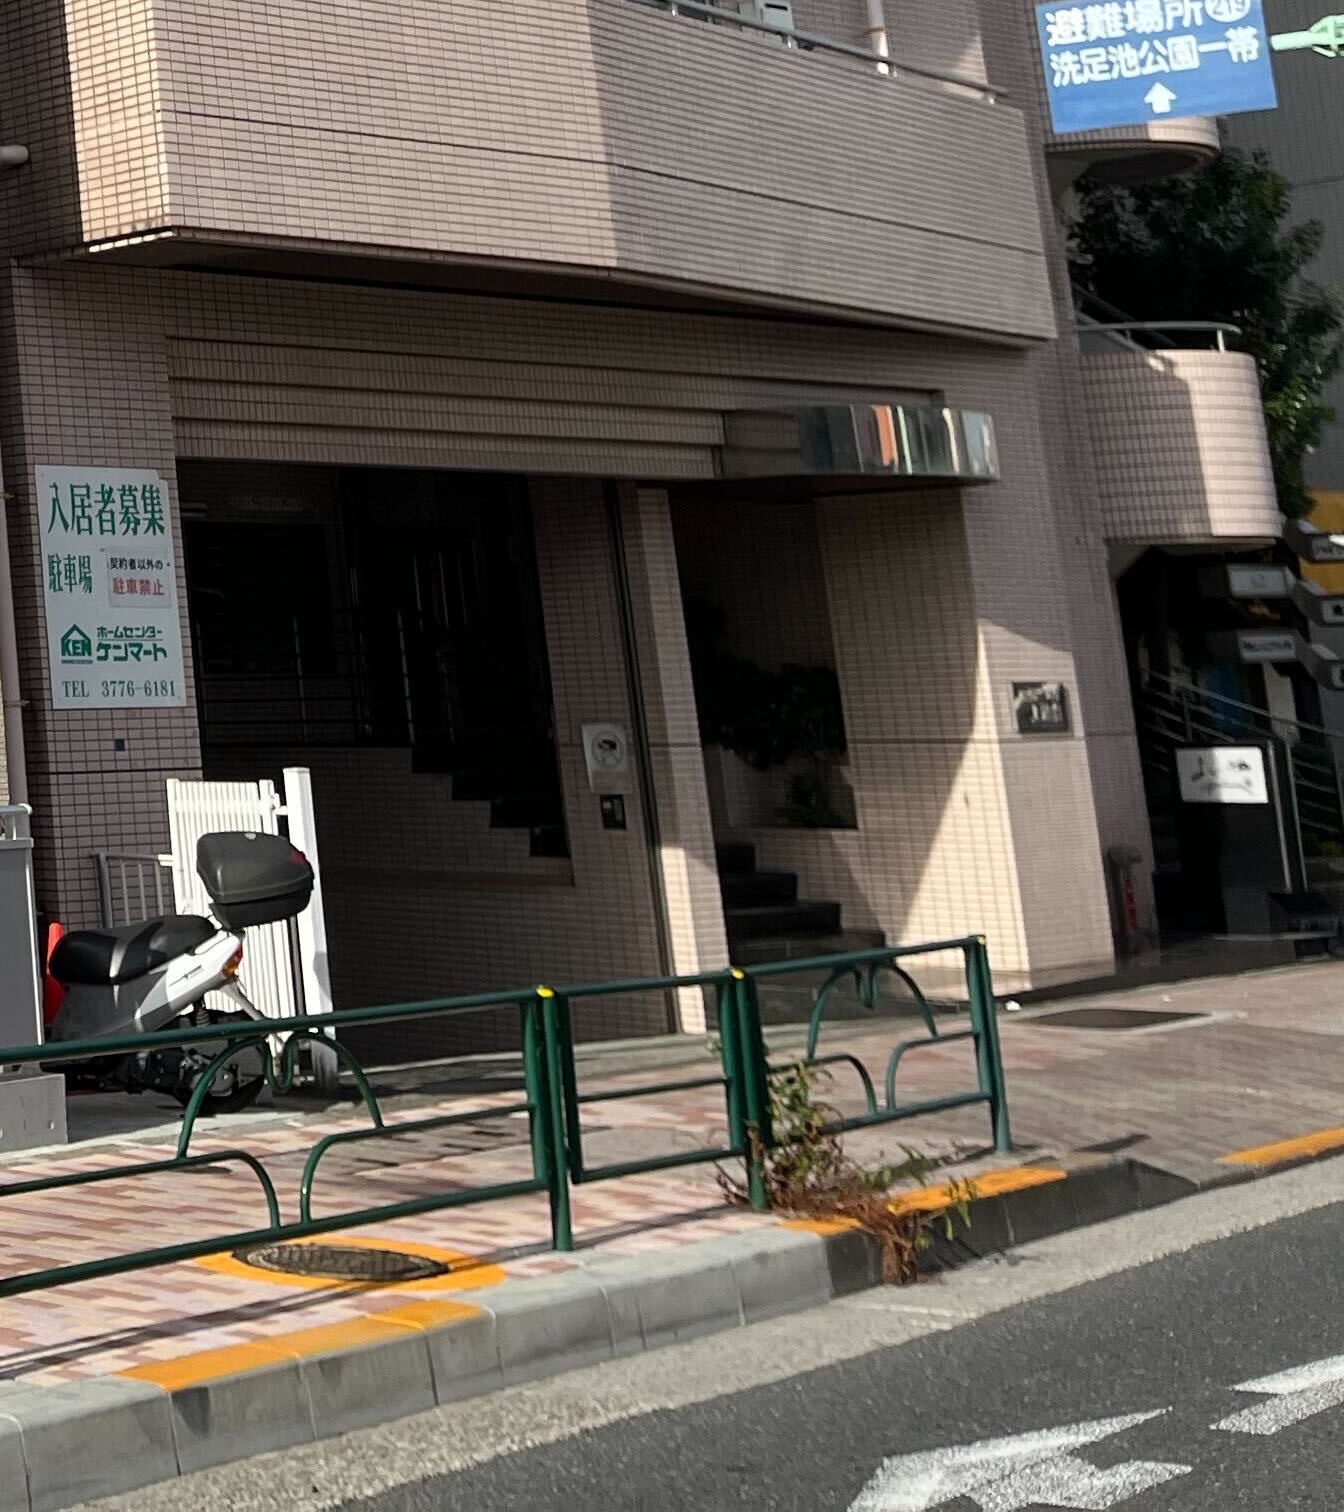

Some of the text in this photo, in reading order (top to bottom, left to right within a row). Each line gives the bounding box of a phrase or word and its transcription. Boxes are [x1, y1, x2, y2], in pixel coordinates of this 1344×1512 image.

[1050, 25, 1259, 87] 洗足池公園一帯
[47, 482, 165, 535] 入居者募集
[47, 553, 92, 594] 駐車場
[97, 626, 163, 638] ホームセンター
[61, 639, 92, 656] KEN
[96, 641, 168, 662] ケンマート
[62, 680, 90, 698] TEL
